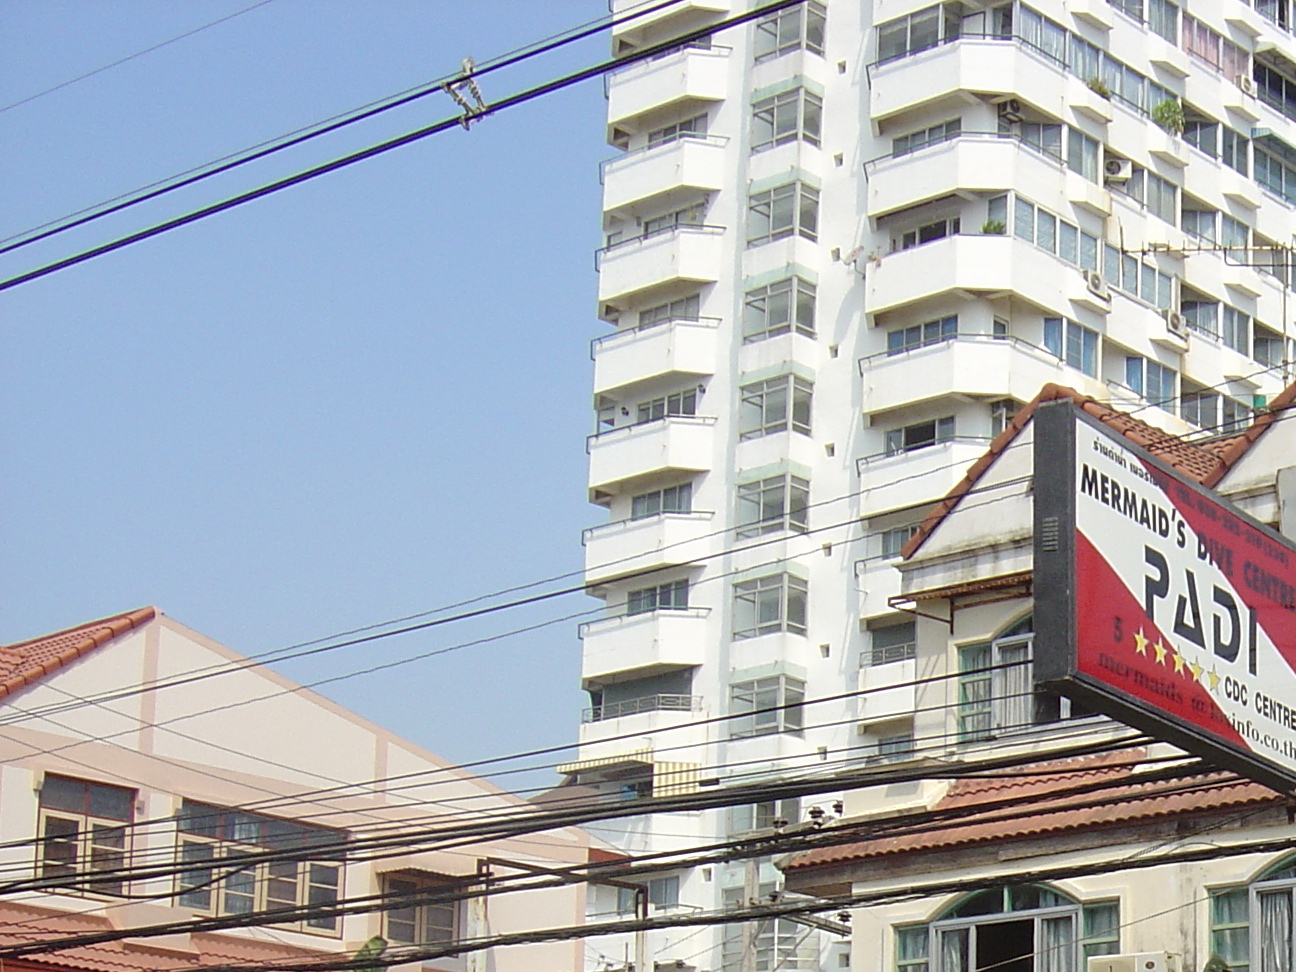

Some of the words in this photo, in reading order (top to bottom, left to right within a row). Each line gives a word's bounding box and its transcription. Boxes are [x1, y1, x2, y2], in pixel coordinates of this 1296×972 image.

[1081, 463, 1186, 549] MERMAID'S
[1197, 532, 1233, 577] DIVE
[1243, 560, 1296, 611] CENTRE
[1144, 545, 1257, 677] PADI
[1224, 676, 1248, 707] CDC
